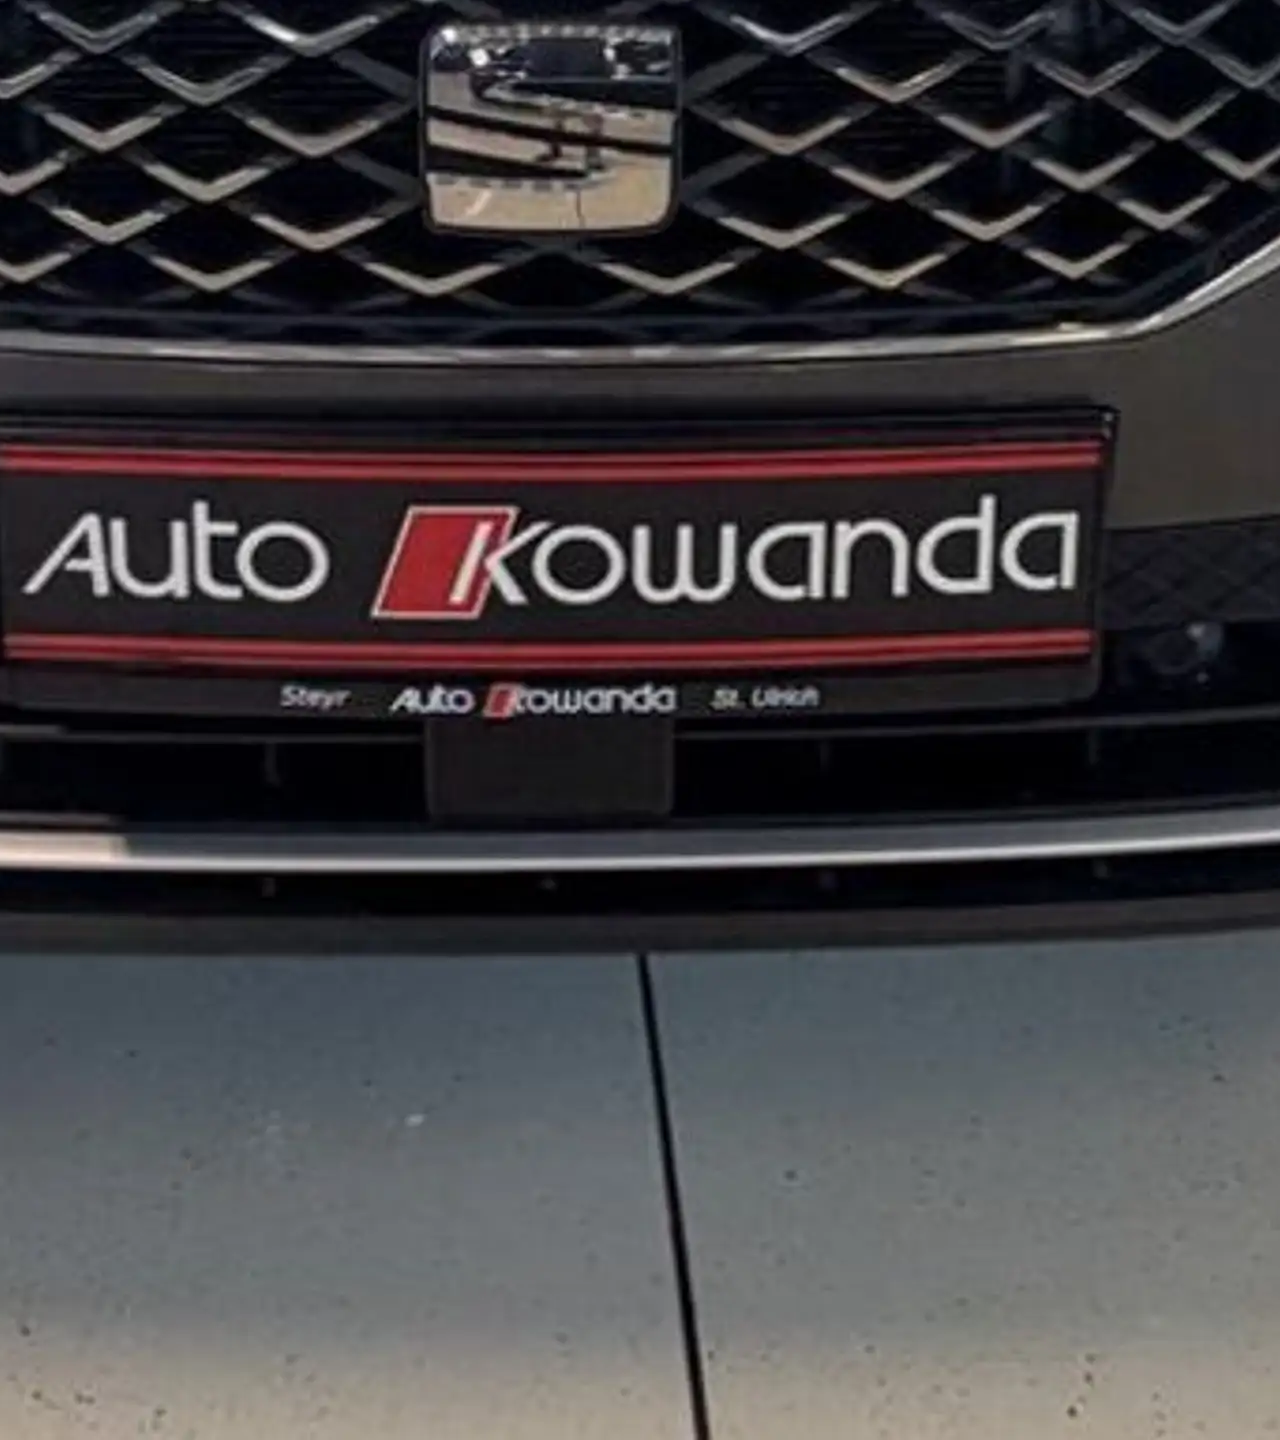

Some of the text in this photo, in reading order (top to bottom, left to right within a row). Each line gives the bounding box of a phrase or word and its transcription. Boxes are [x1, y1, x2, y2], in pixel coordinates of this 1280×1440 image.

[22, 493, 1081, 606] Auto Kowanda
[388, 683, 476, 714] Auto
